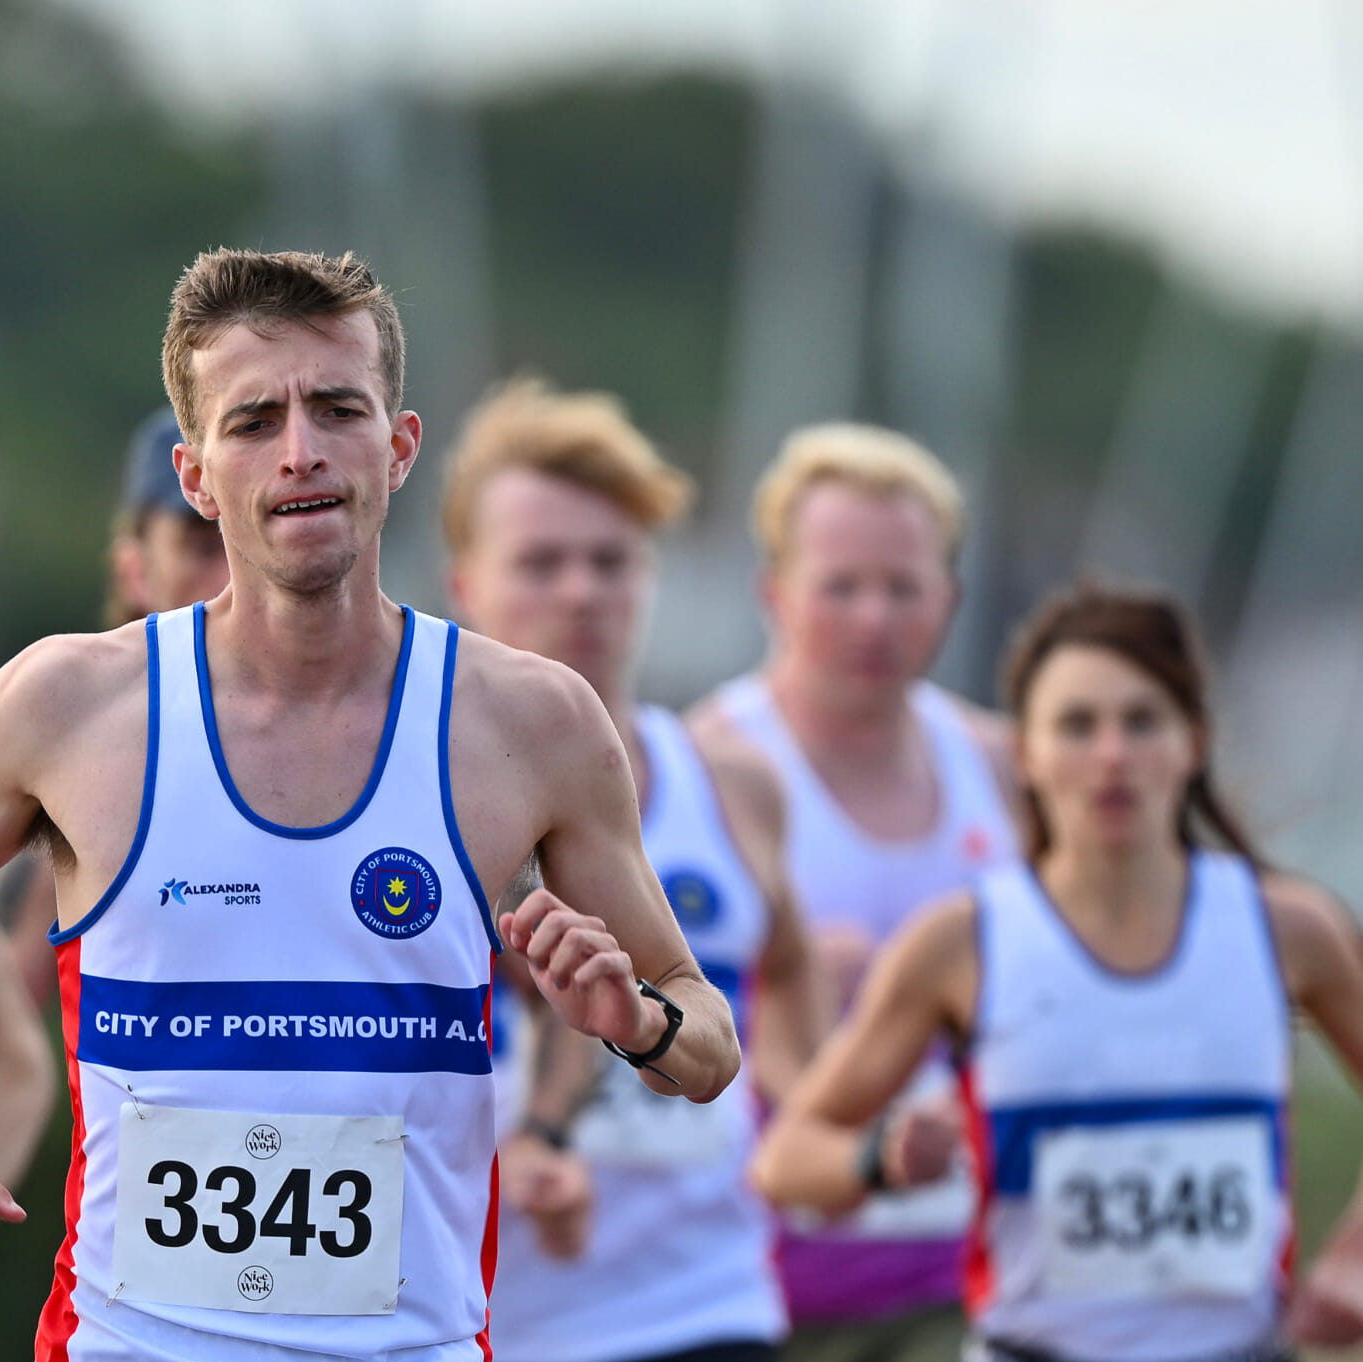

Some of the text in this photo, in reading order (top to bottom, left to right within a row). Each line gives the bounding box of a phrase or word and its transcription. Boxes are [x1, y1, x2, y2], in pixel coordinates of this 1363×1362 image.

[355, 852, 436, 901] CITY OF PORTSMOUTH
[183, 883, 261, 896] ALEXANDRA
[224, 895, 262, 906] SPORTS
[361, 911, 433, 934] ATHLETIC CLUB
[95, 1010, 159, 1038] CITY
[169, 1014, 212, 1038] OF
[223, 1014, 437, 1039] PORTSMOUTH
[251, 1128, 276, 1142] Nice
[248, 1140, 278, 1152] Work
[144, 1159, 373, 1258] 3343
[1060, 1166, 1251, 1250] 3346
[244, 1270, 269, 1284] Nice
[240, 1280, 270, 1293] Work
